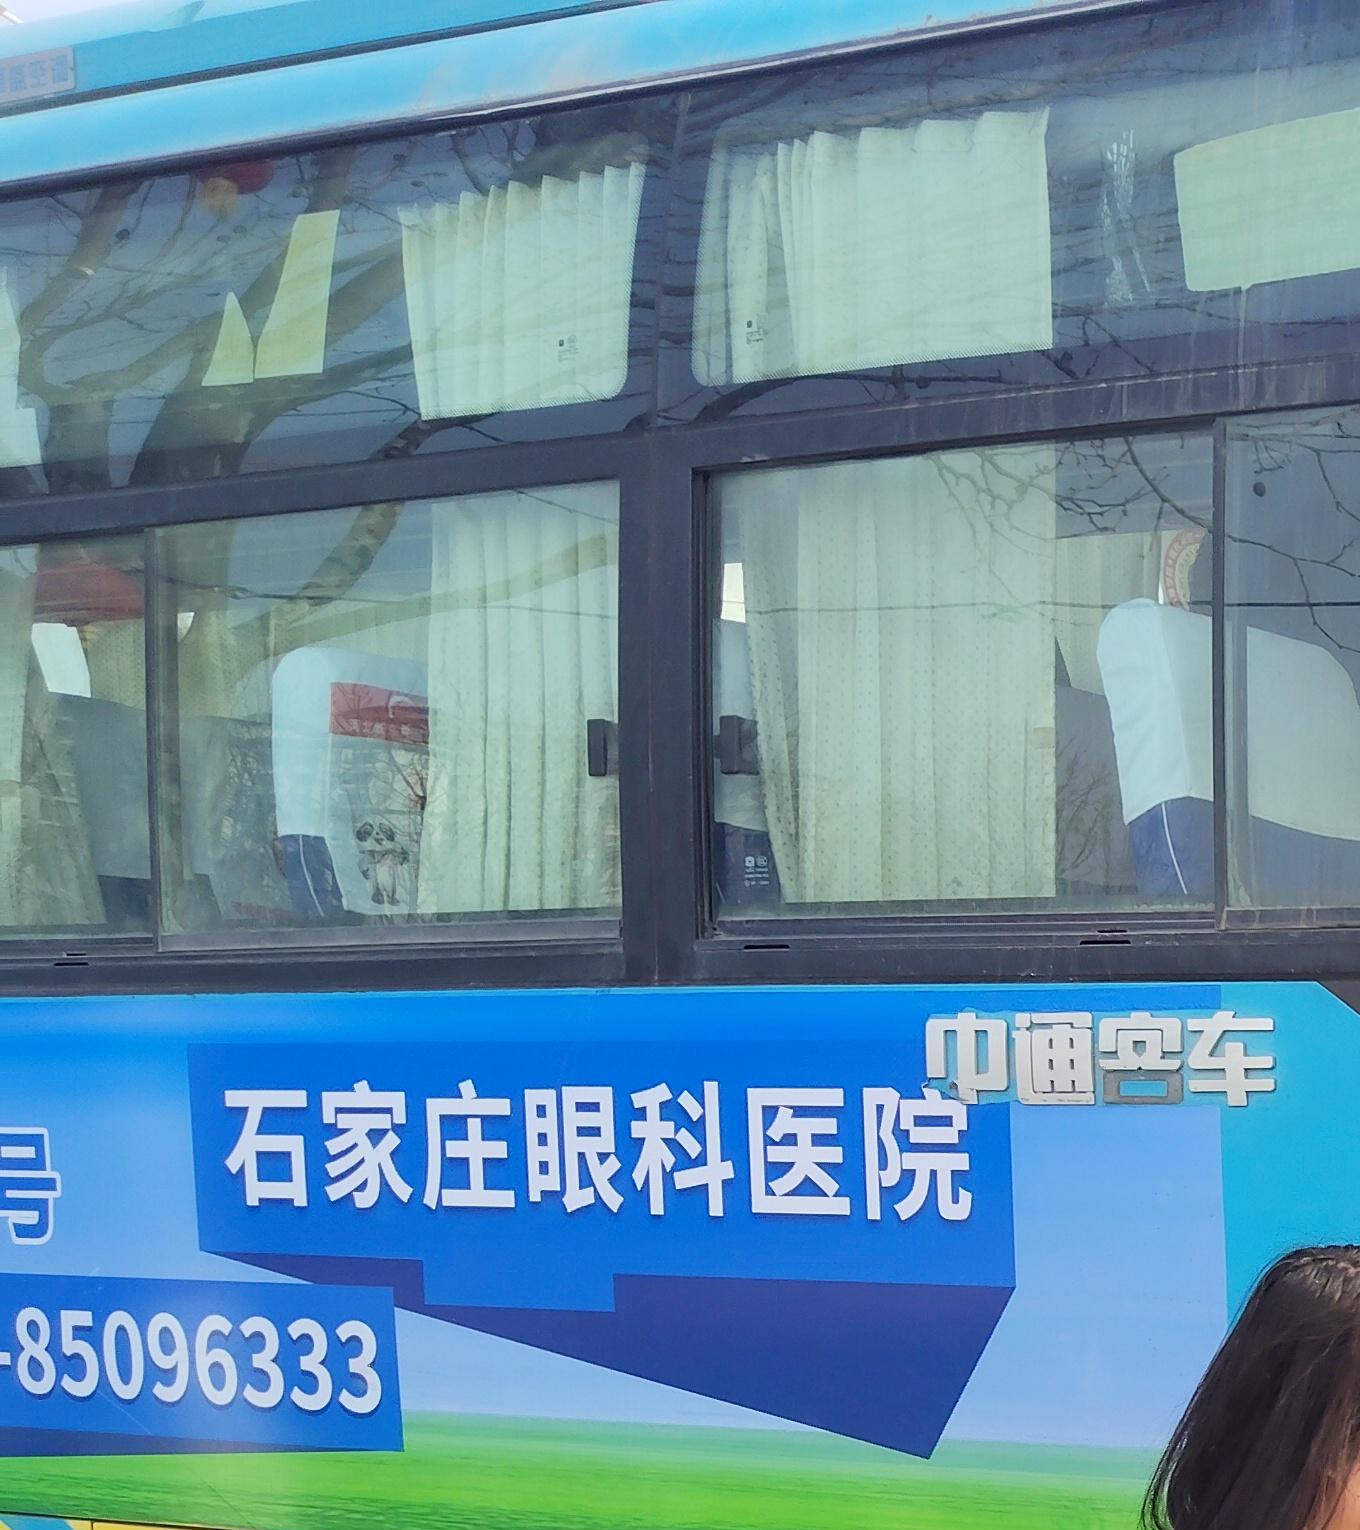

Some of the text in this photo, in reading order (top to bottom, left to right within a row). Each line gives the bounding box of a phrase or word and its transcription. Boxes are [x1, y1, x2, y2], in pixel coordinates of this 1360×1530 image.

[925, 1010, 1277, 1107] 中通客车
[222, 1078, 973, 1223] 石家庄眼科医院
